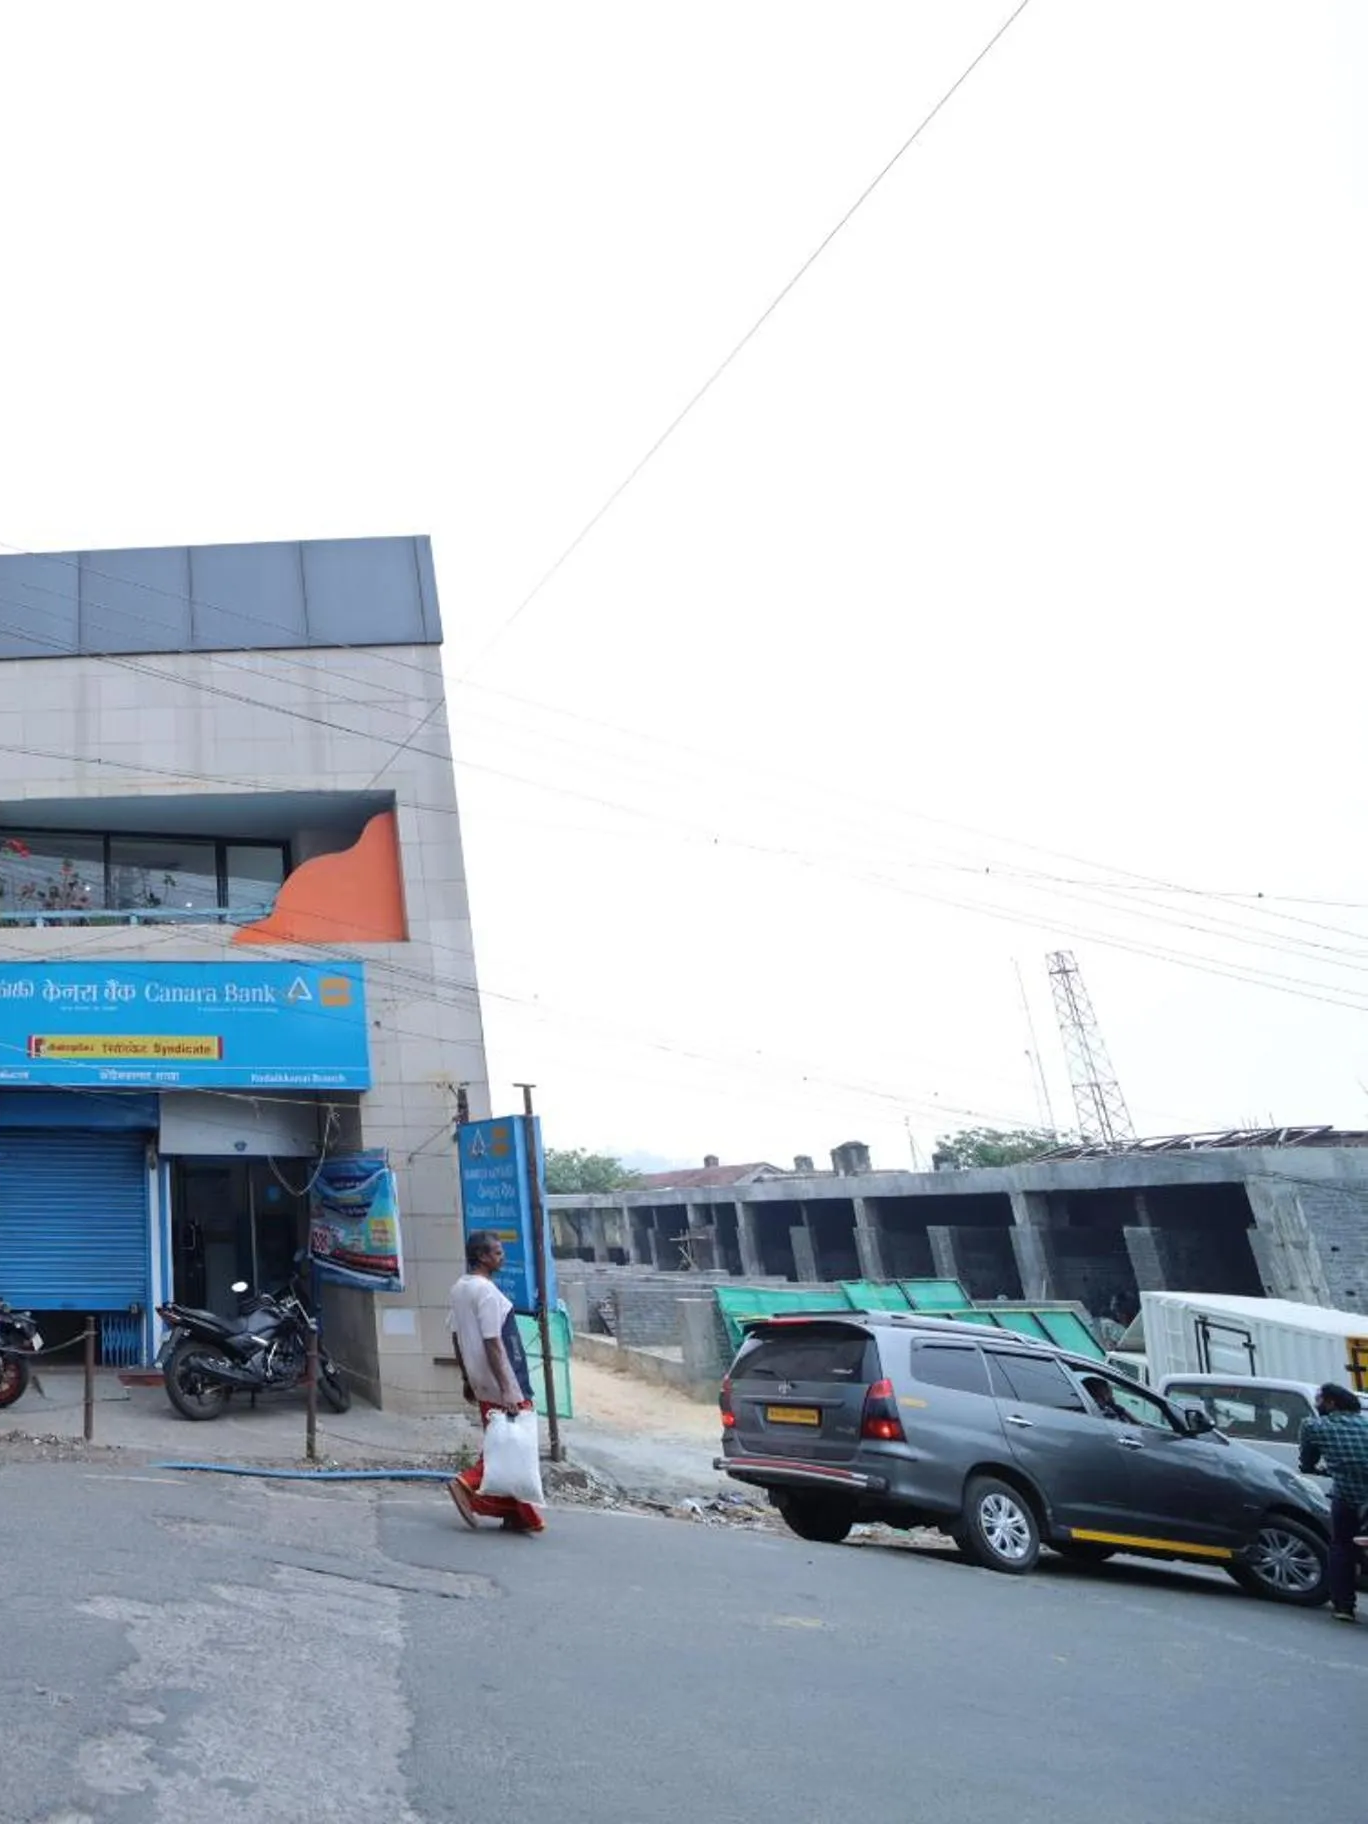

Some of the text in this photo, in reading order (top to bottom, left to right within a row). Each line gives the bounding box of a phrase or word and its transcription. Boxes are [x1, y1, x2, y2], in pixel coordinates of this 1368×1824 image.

[103, 978, 136, 1003] बैंक
[145, 982, 276, 1003] Canara Bank
[154, 1042, 211, 1056] Syndicate
